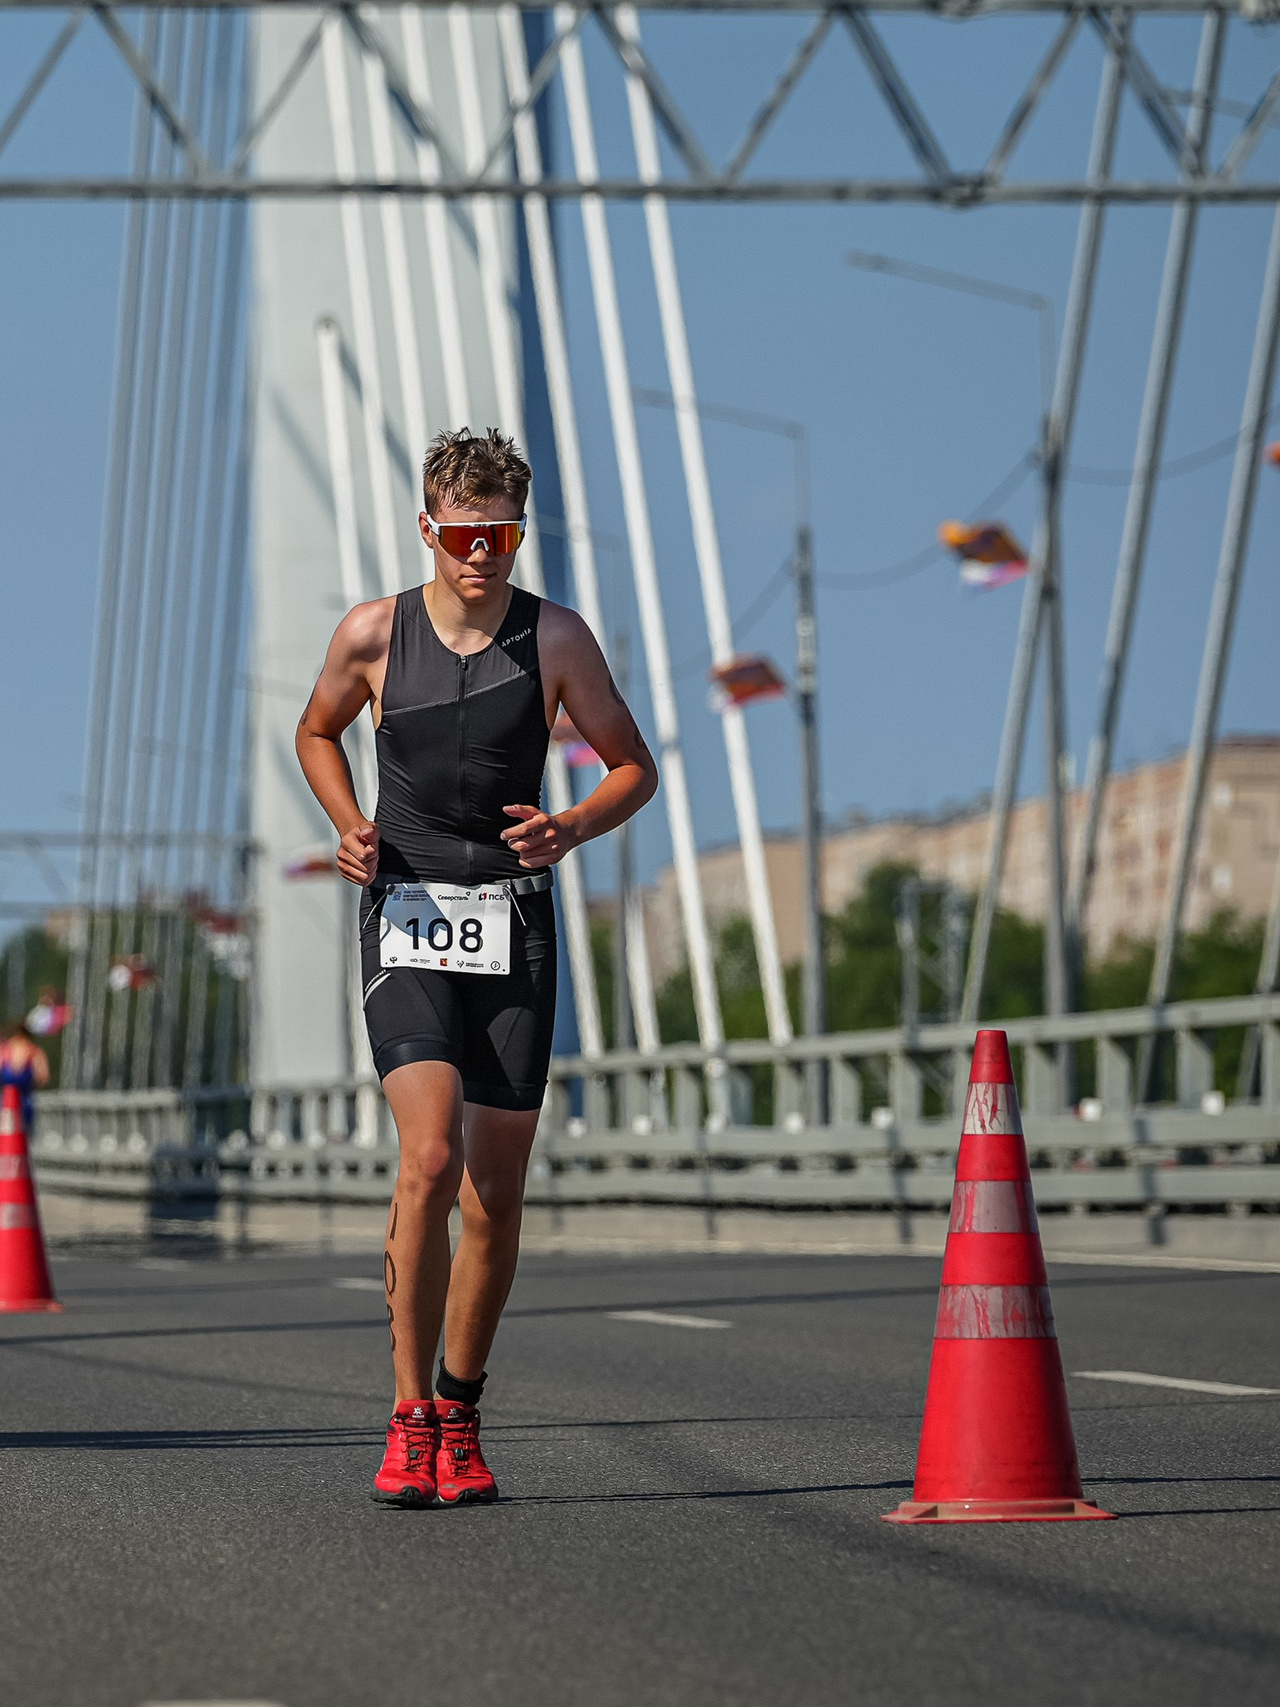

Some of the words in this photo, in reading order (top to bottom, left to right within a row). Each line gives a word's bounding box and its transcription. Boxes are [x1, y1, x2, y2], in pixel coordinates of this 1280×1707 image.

[501, 628, 532, 647] APTONIA
[437, 894, 469, 902] Северсталь
[405, 917, 484, 953] 108
